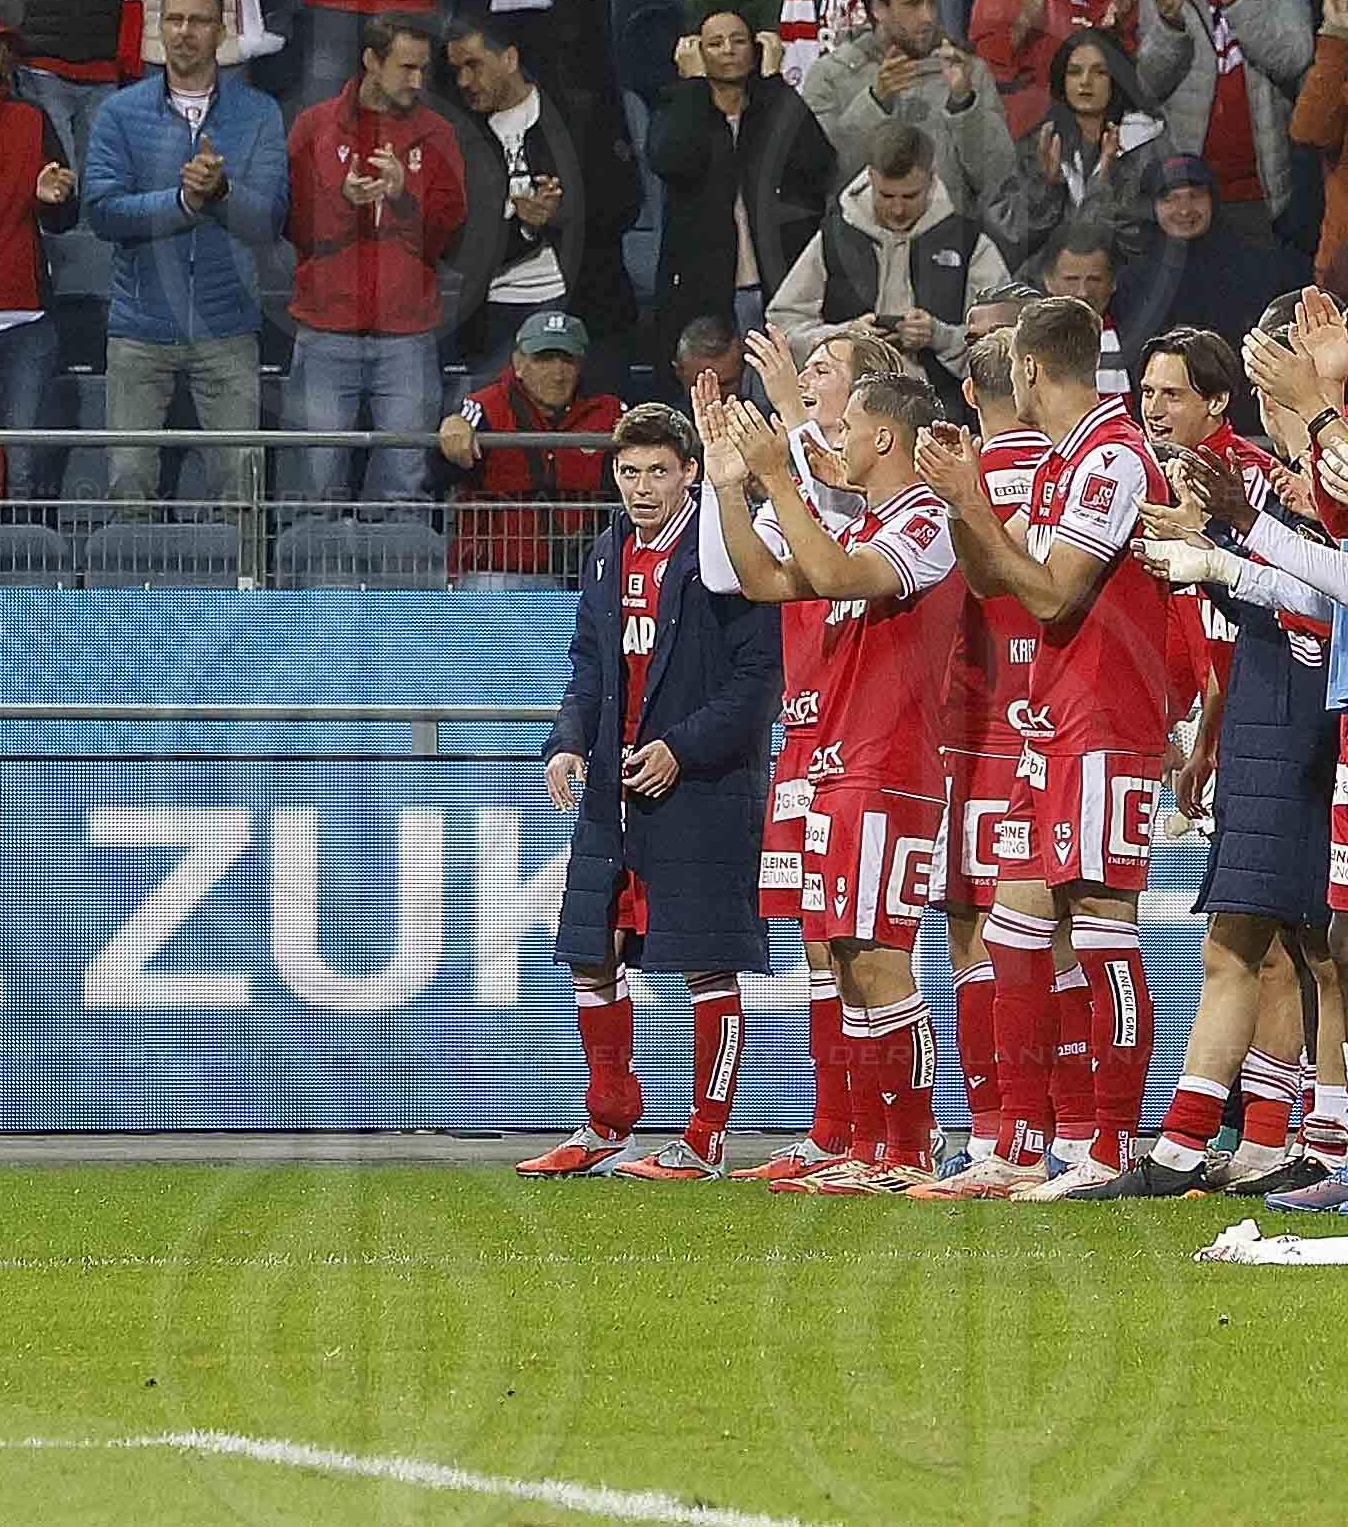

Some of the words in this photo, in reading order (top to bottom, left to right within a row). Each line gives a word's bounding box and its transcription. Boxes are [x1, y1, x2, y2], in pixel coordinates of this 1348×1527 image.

[1053, 823, 1071, 839] 15
[837, 877, 845, 893] 8
[83, 804, 582, 1012] ZUK
[1123, 1018, 1136, 1044] GRAZ
[715, 1070, 731, 1099] GRAZ
